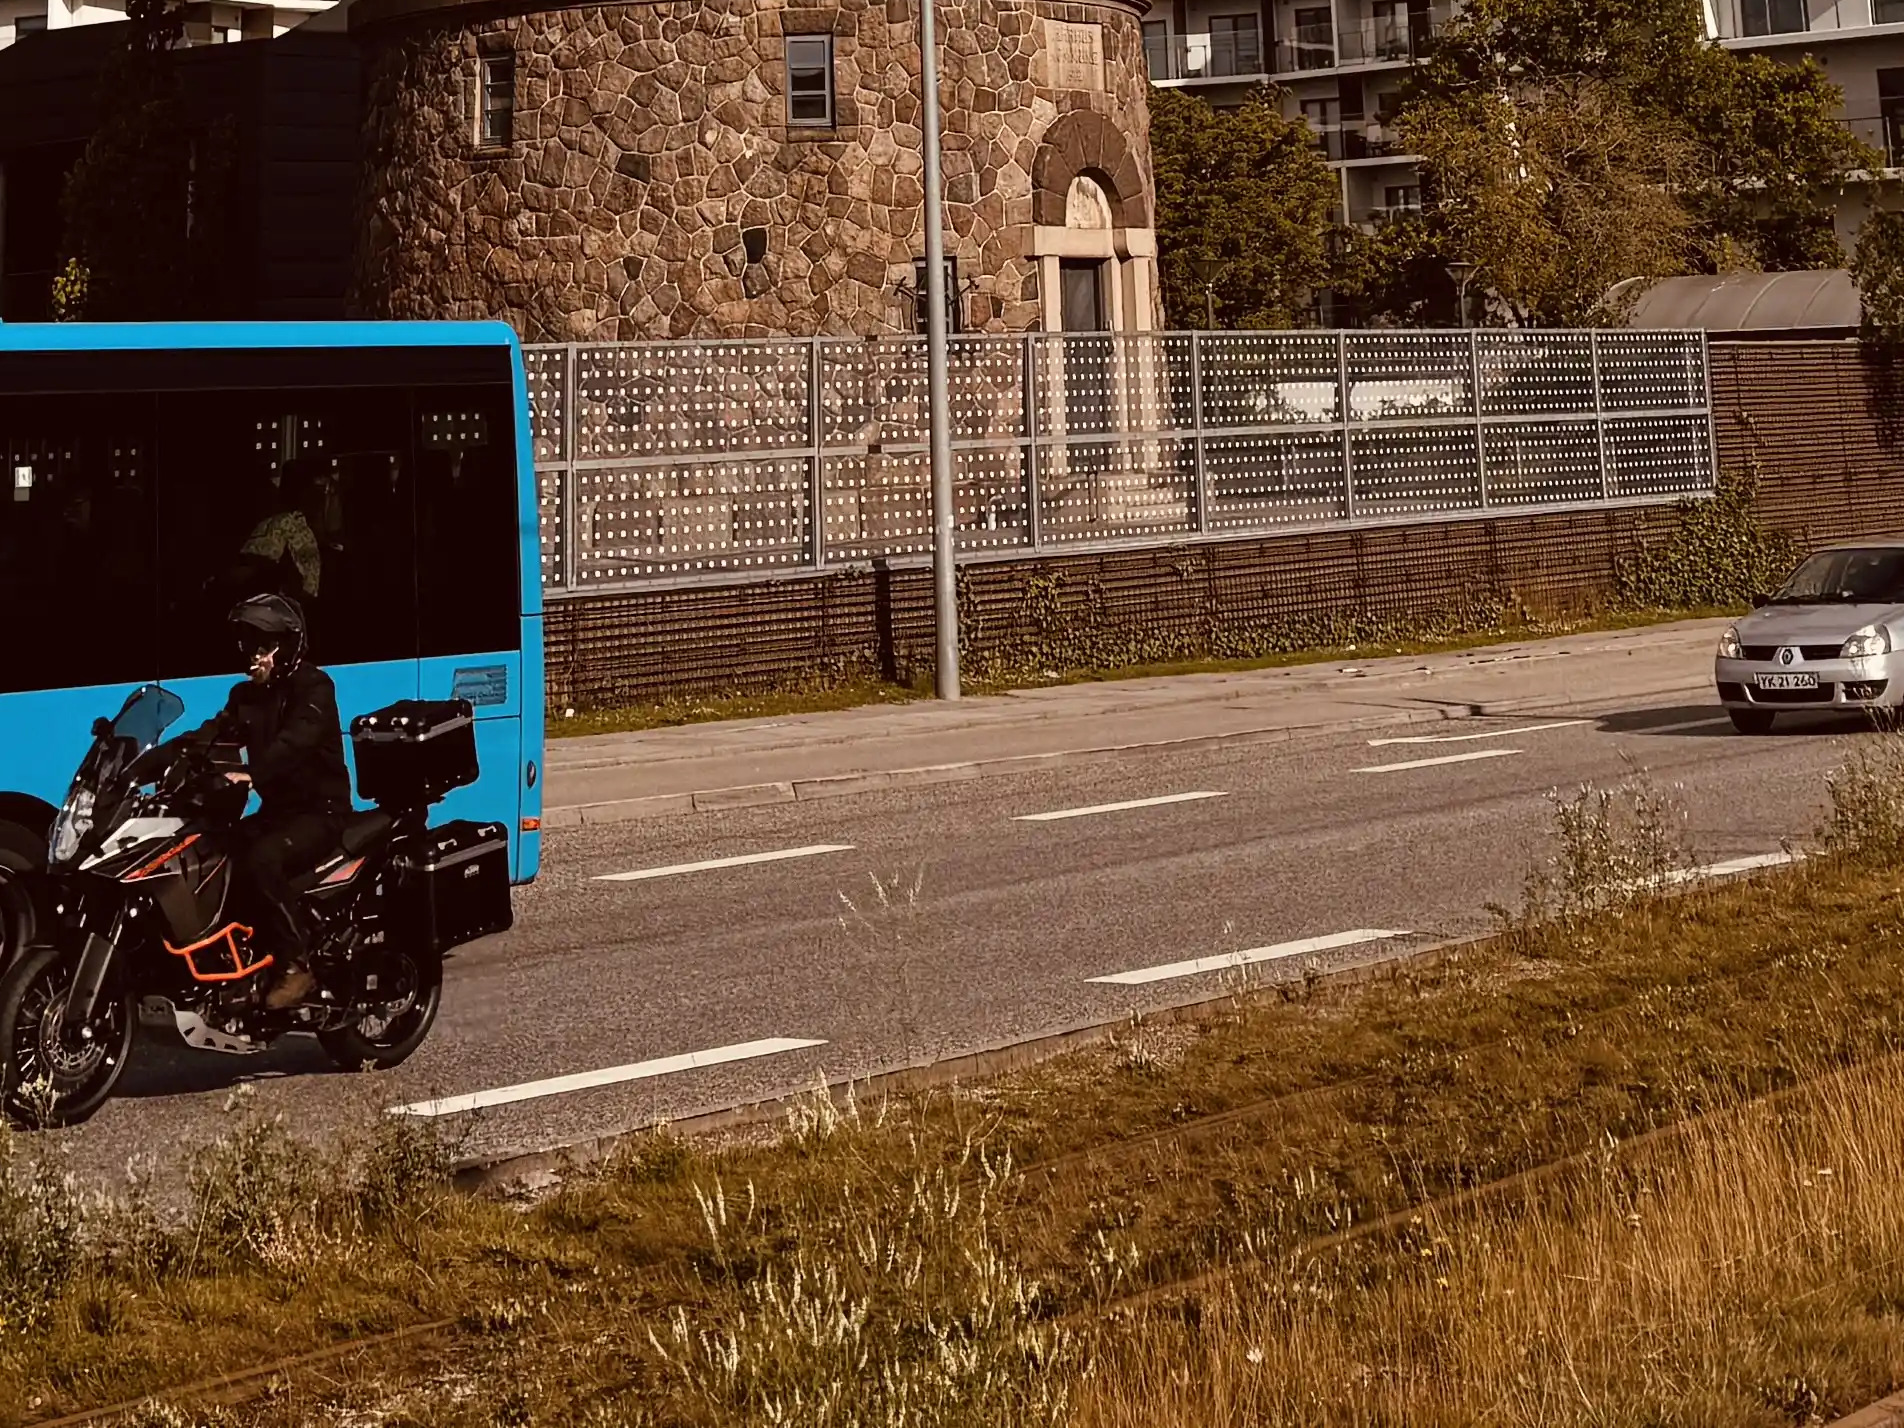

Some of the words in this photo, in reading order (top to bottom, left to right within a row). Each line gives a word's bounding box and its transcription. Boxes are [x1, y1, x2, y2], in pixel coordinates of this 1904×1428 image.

[1760, 675, 1775, 689] YK
[1777, 675, 1791, 688] 21
[1793, 674, 1816, 687] 260
